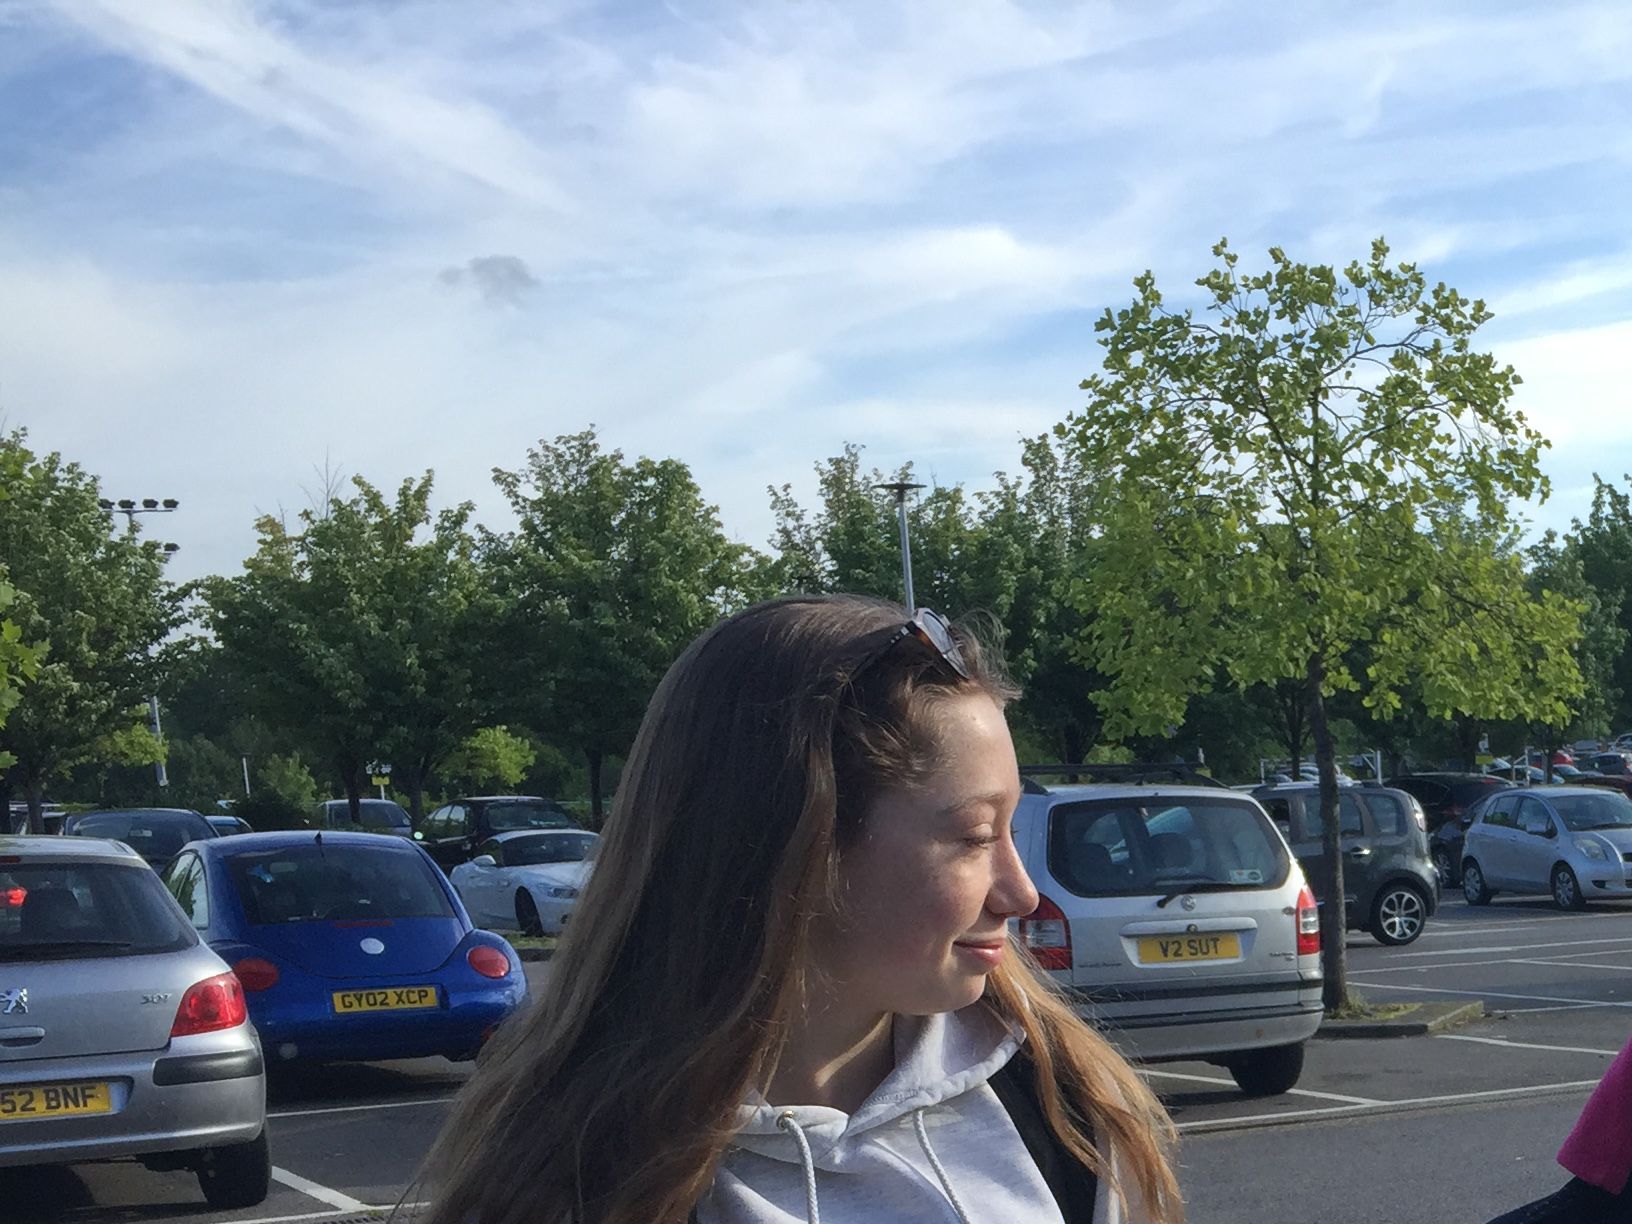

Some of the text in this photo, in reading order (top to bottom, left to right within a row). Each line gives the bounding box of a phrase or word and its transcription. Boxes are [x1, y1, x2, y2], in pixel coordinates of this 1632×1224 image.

[1159, 938, 1220, 958] V2 SUT
[341, 989, 429, 1009] GY02 XCP
[43, 1086, 97, 1110] BNF
